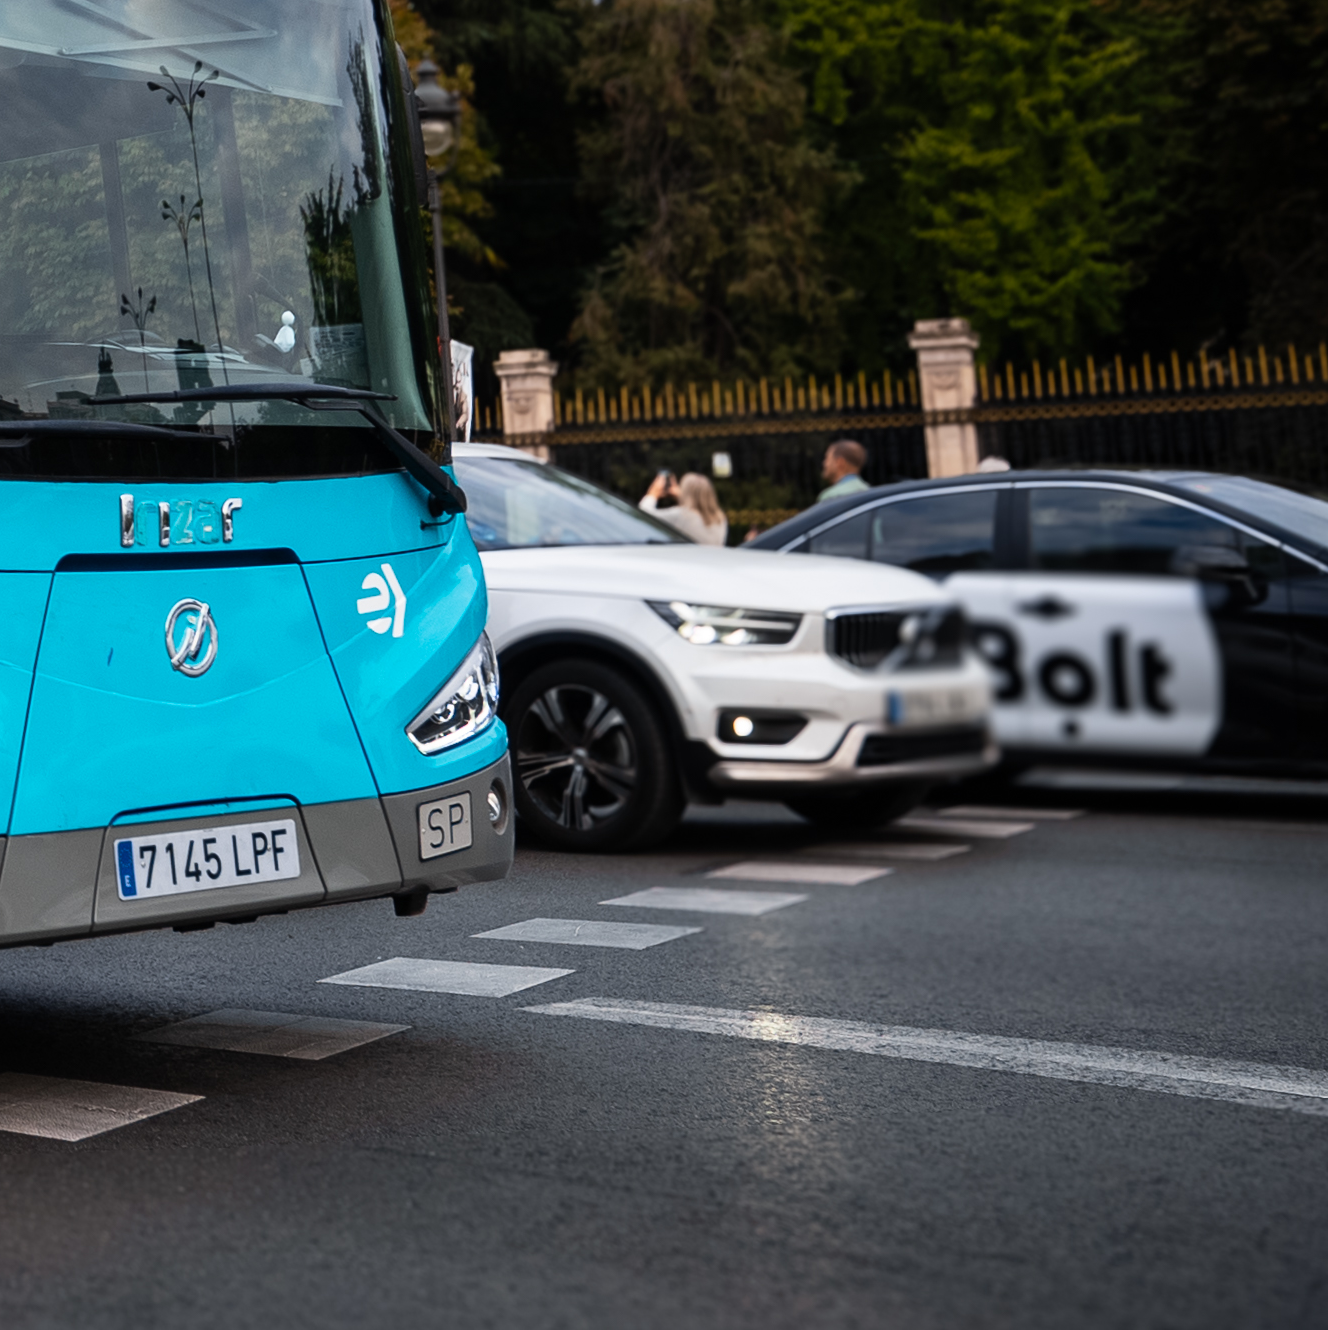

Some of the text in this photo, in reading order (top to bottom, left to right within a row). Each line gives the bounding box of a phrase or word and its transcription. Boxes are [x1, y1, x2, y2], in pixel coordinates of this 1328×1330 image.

[970, 618, 1177, 717] Bolt
[428, 802, 465, 849] SP
[138, 836, 223, 889] 7145
[231, 828, 287, 877] LPF
